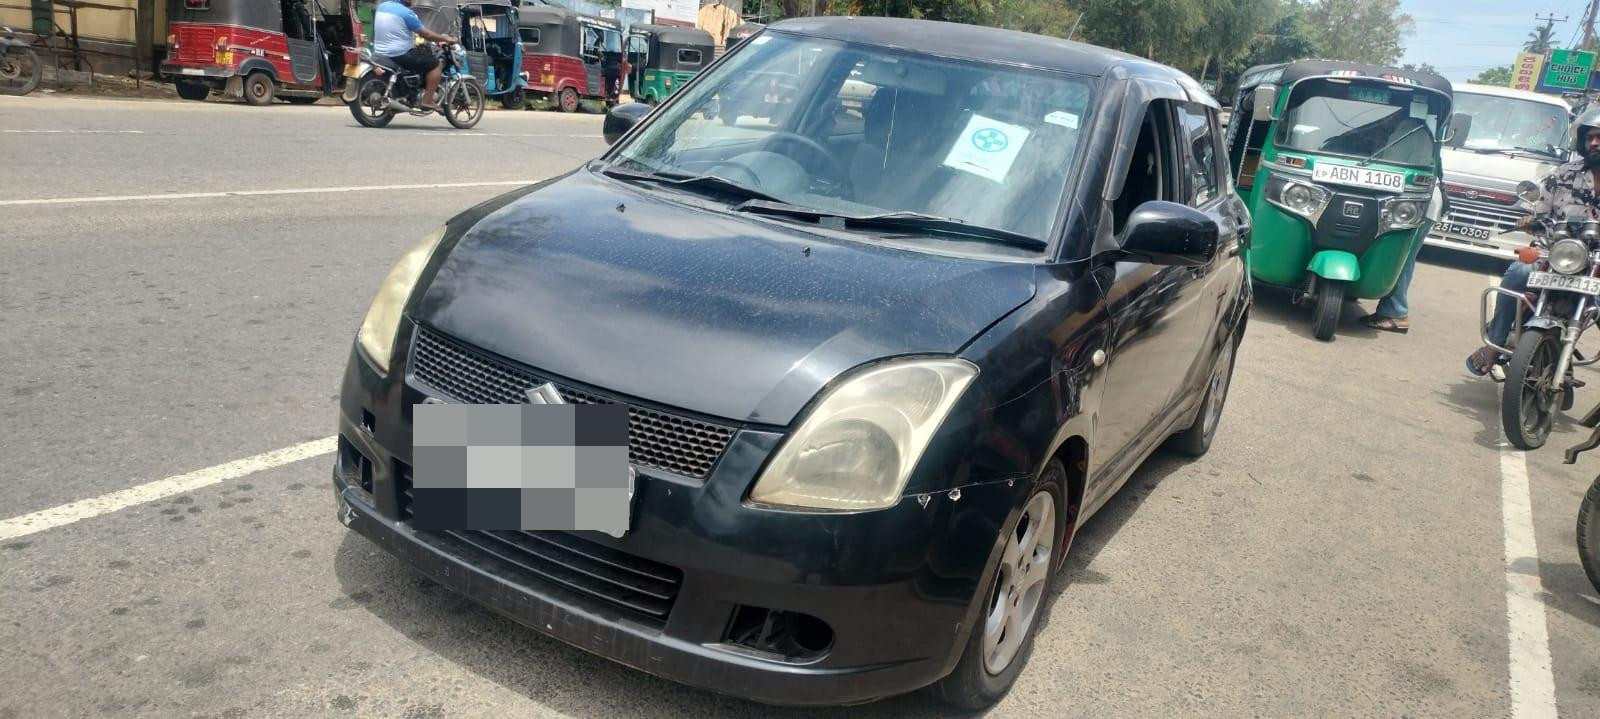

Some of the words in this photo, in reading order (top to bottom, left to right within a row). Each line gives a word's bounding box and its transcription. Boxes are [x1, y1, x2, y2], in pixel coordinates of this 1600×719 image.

[1552, 63, 1586, 75] CHOICE
[1557, 74, 1577, 84] HUB
[1330, 167, 1360, 183] ABN
[1364, 171, 1401, 188] 1108
